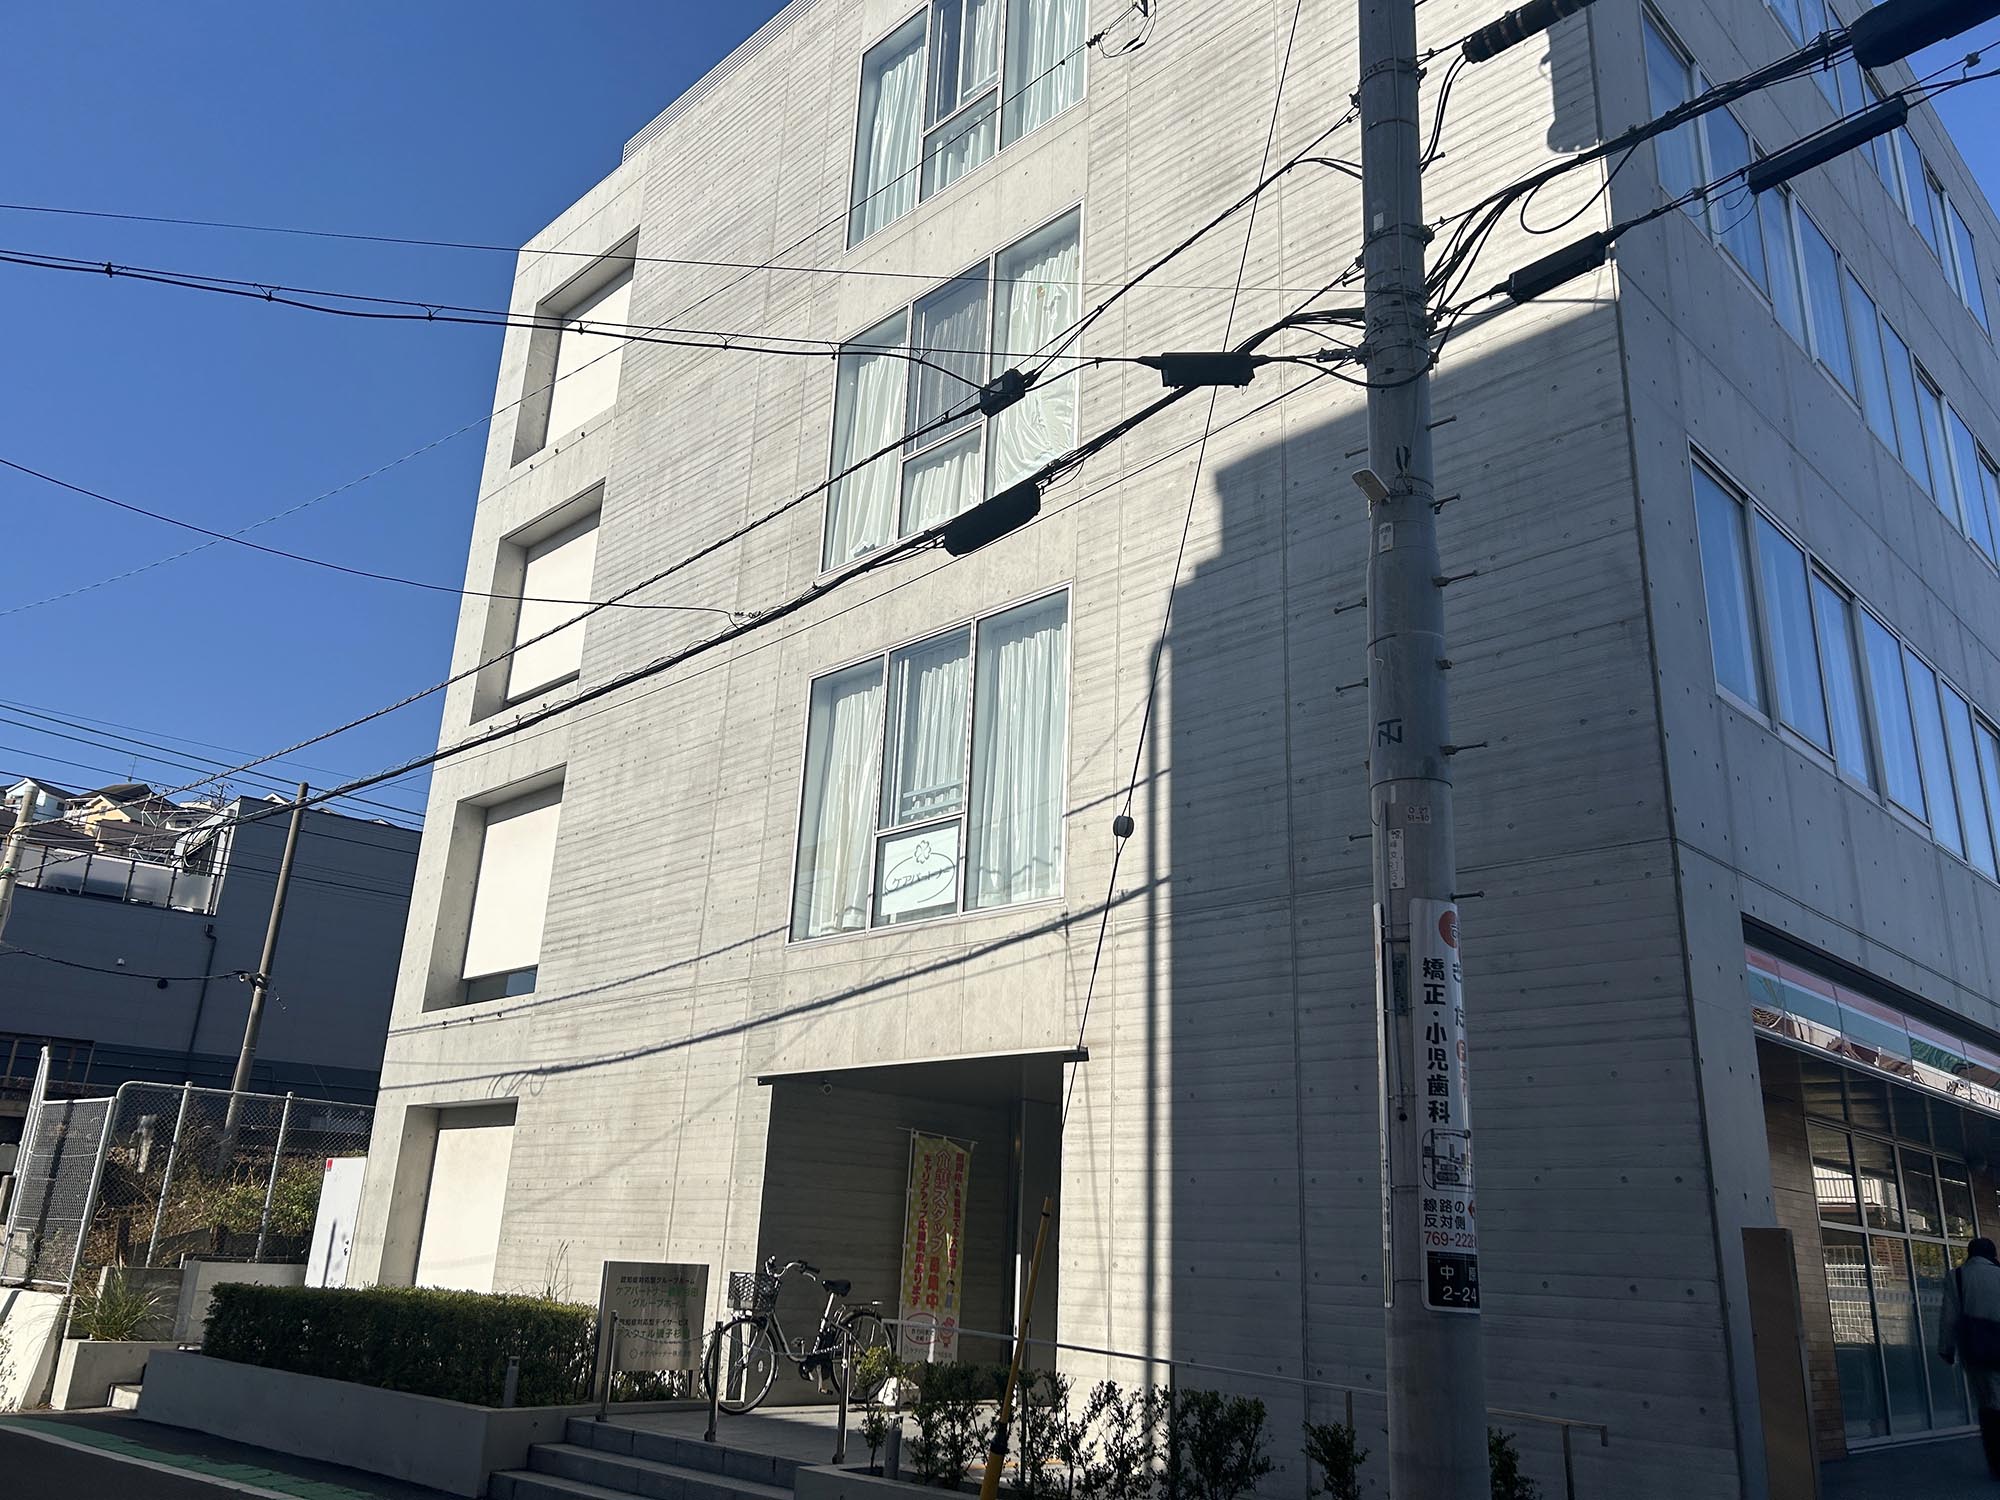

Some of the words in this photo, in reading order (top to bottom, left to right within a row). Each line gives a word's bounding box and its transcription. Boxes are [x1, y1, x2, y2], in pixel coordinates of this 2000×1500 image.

[1423, 957, 1450, 1124] 矯正・小児歯科
[1423, 1198, 1465, 1213] 線路の
[1424, 1213, 1466, 1230] 反対側
